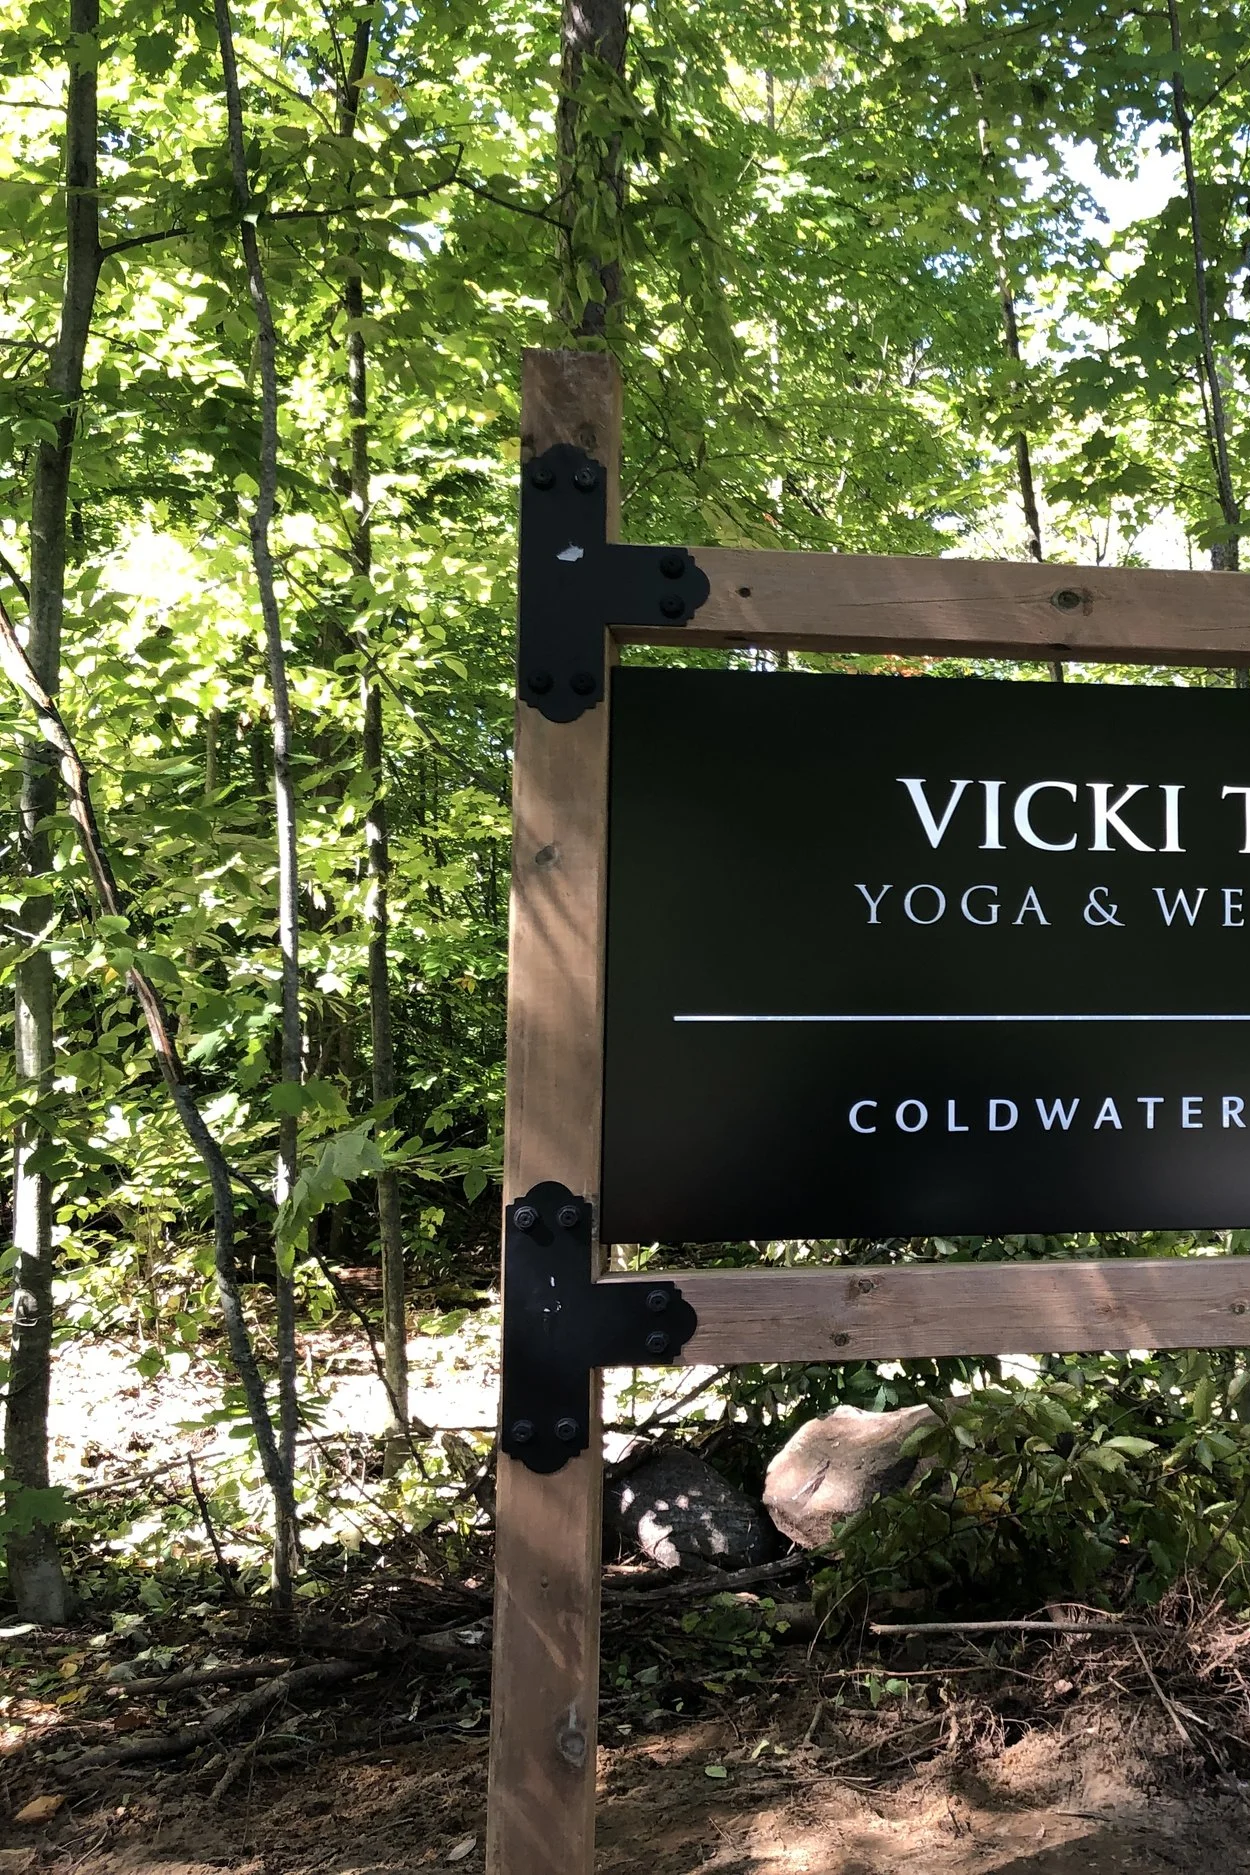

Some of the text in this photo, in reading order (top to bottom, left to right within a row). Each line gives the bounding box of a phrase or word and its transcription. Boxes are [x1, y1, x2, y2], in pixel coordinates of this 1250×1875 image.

[895, 777, 1188, 853] VICKI
[854, 883, 1053, 927] YOGA
[1082, 885, 1127, 927] &
[847, 1096, 1248, 1134] COLDWATER
